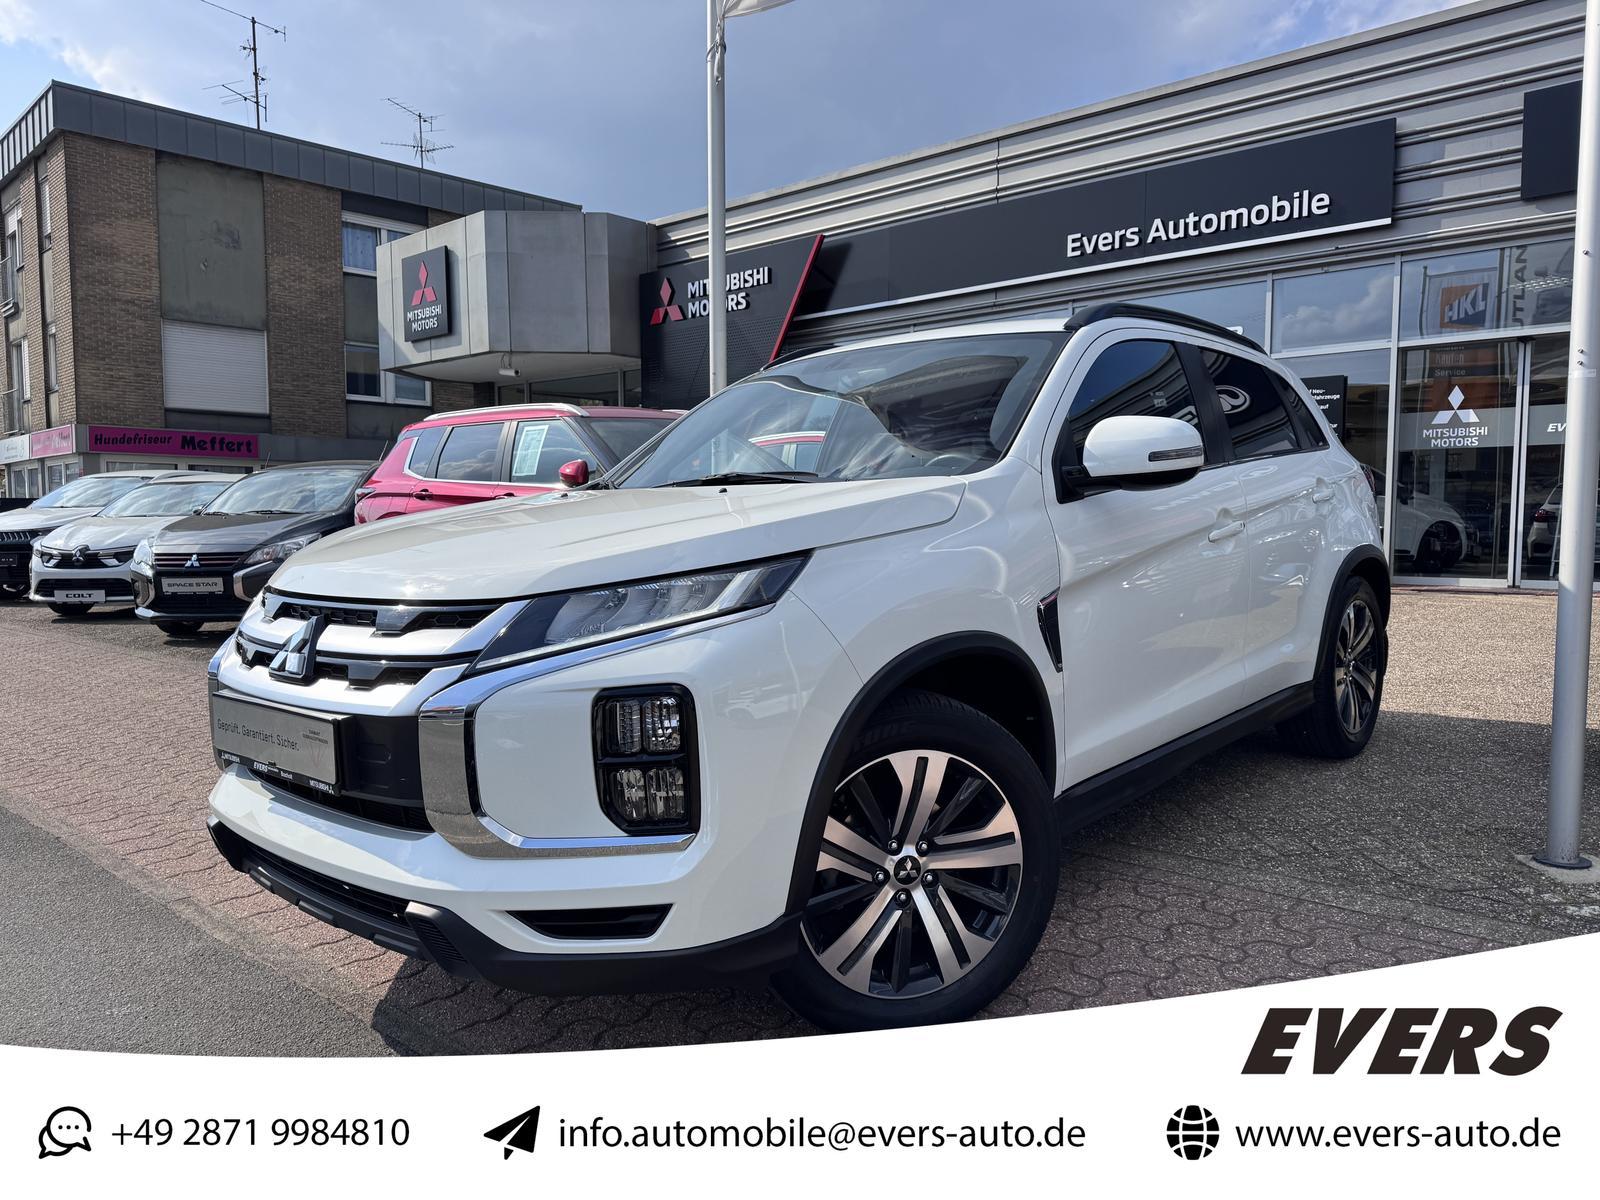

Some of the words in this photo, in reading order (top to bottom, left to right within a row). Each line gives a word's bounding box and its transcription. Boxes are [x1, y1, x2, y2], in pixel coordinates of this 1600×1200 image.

[1066, 226, 1140, 258] Evers
[1146, 189, 1331, 243] Automobile
[687, 266, 769, 299] MITBISHI
[407, 304, 442, 322] MITSUBISHI
[688, 292, 747, 319] MORS
[412, 317, 438, 332] MOTORS
[1423, 426, 1488, 438] MITSUBISHI
[1547, 423, 1567, 432] EV
[94, 433, 172, 446] Hundefriseur
[181, 435, 253, 453] Meffert
[1431, 437, 1479, 447] MOTORS
[195, 580, 218, 588] STAR
[217, 718, 240, 735] Geprüft.
[241, 725, 276, 744] Garantiert.
[276, 733, 300, 751] Sicher.
[253, 761, 268, 773] EVERS
